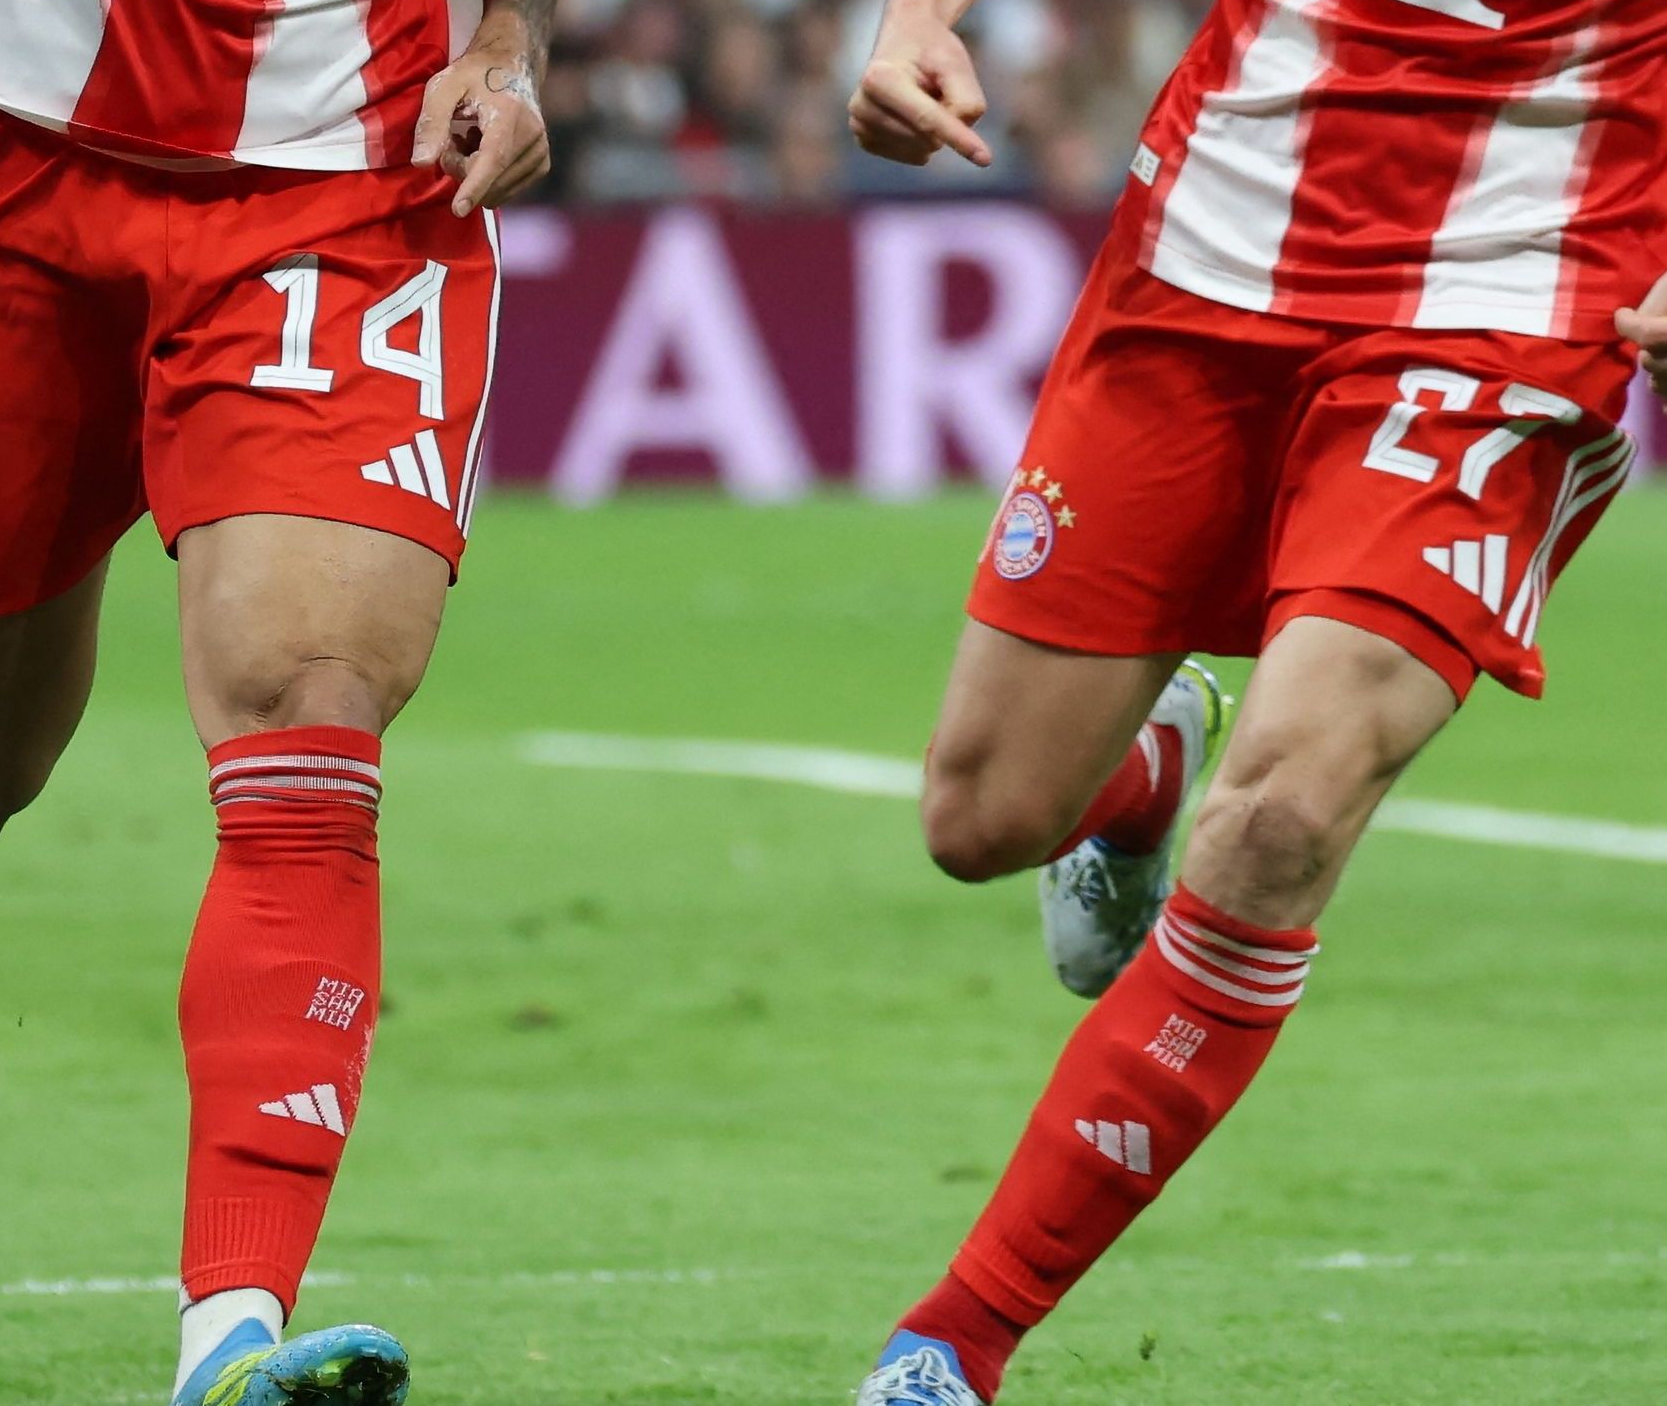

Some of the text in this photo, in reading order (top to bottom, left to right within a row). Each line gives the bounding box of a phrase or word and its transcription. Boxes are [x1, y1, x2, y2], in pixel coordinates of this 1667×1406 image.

[249, 252, 446, 422] 14
[1361, 365, 1583, 501] 27
[312, 991, 357, 1017] SAN
[316, 976, 365, 1005] MIA
[305, 1004, 351, 1031] MIA
